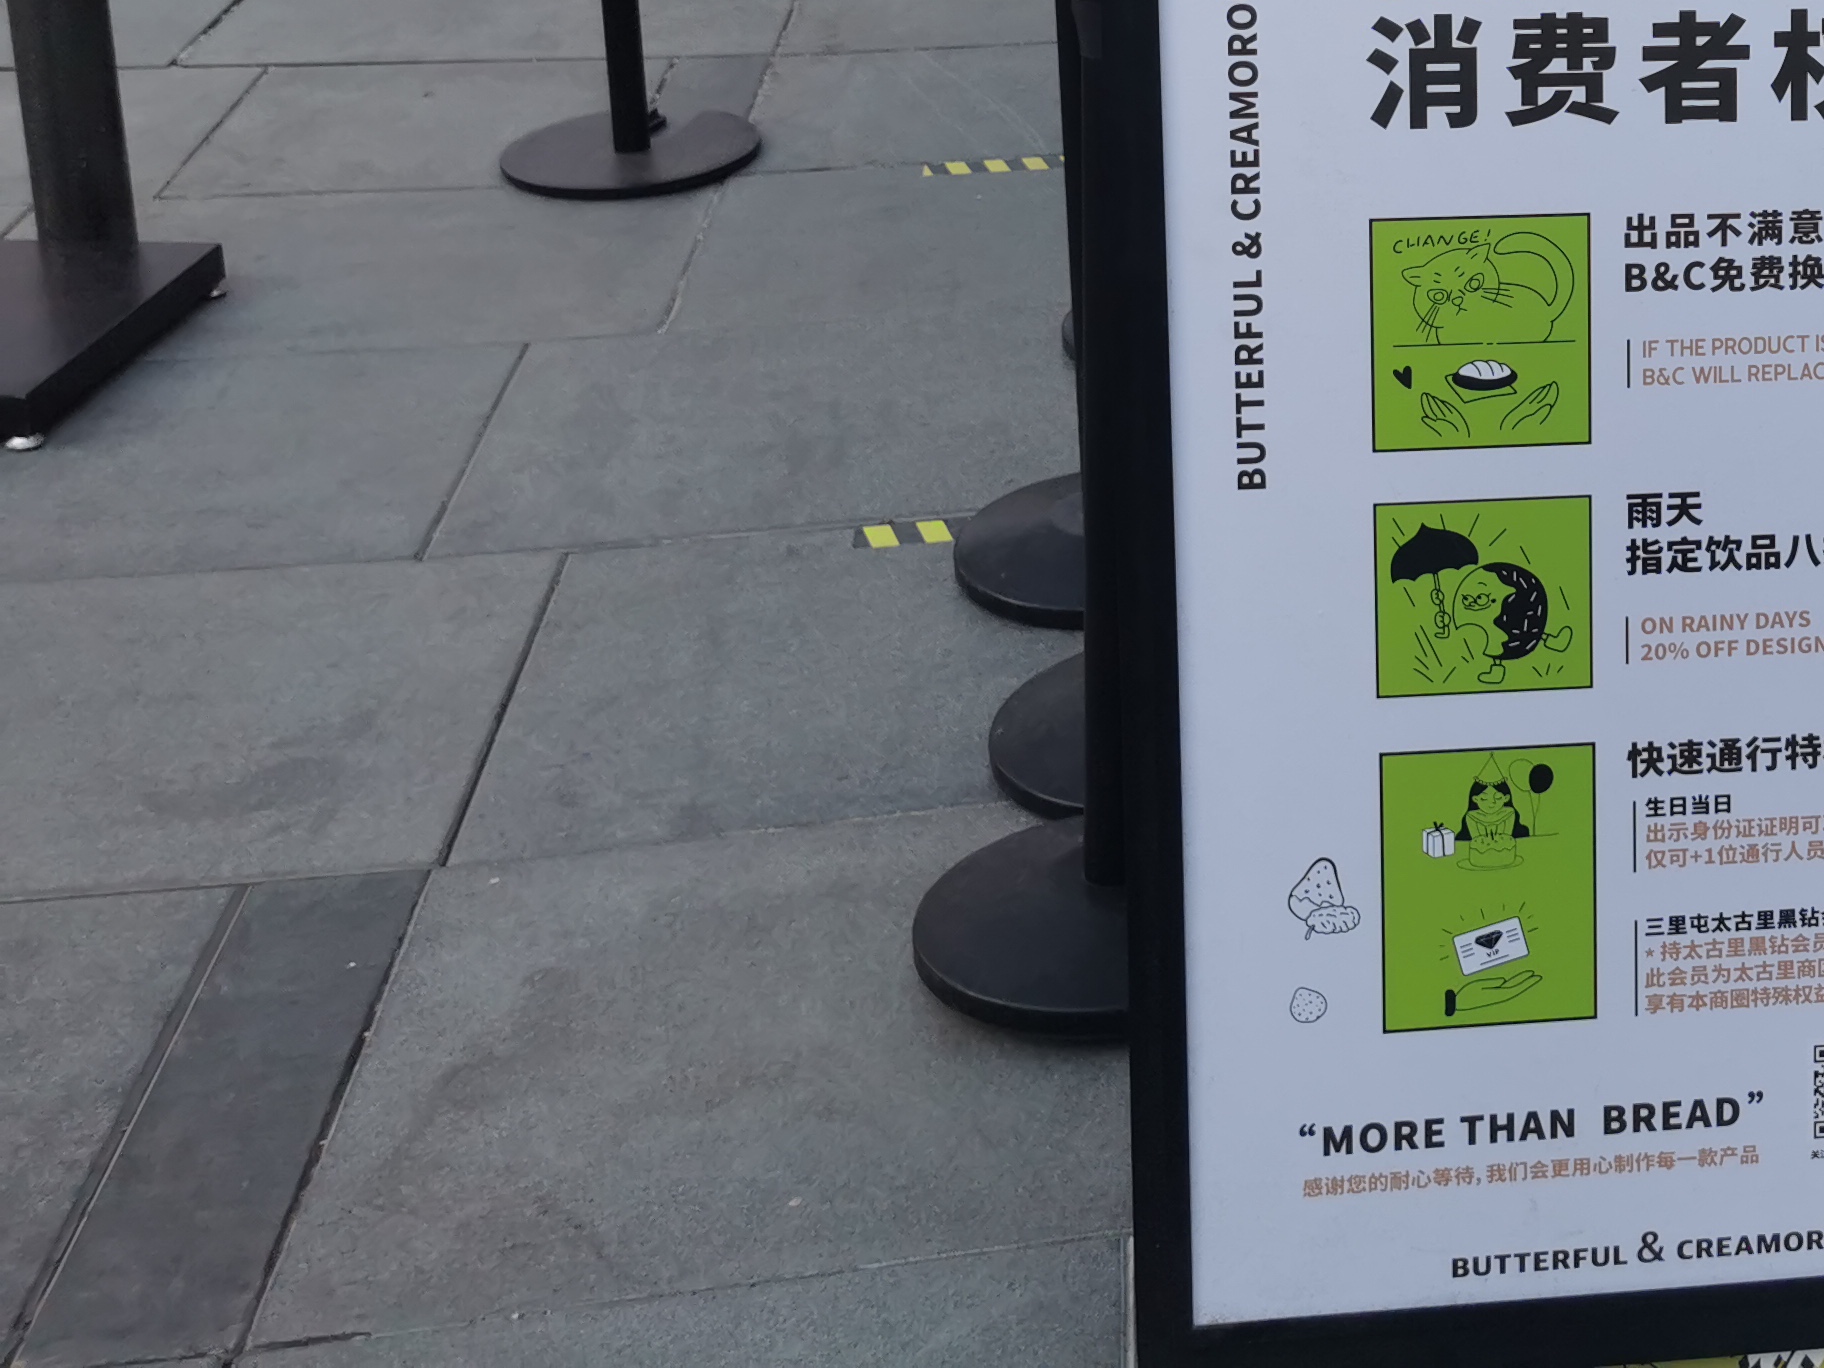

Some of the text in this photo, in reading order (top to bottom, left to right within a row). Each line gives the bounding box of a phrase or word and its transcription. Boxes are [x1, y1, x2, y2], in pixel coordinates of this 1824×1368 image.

[1231, 231, 1263, 260] &
[1624, 209, 1823, 249] 出品不满意
[1625, 254, 1824, 292] B&C免费换
[1643, 340, 1659, 358] IF
[1666, 339, 1706, 357] THE
[1712, 335, 1810, 355] PRODUCT
[1233, 269, 1267, 492] BUTTERFUL
[1643, 367, 1684, 385] B&C
[1692, 366, 1741, 384] WILL
[1626, 492, 1703, 529] 雨天
[1641, 611, 1810, 634] ON RAINY DAYS
[1641, 642, 1689, 661] 20%
[1696, 640, 1738, 658] OFF
[1645, 794, 1730, 817] 生日当日
[1646, 841, 1824, 869] 仅可+1位通行人员
[1460, 1108, 1574, 1145] THAN
[1303, 1145, 1759, 1197] 感谢您的耐心等待,我们会更用心制作每一款产品
[1452, 1247, 1627, 1278] BUTTERFUL
[1637, 1233, 1664, 1263] &
